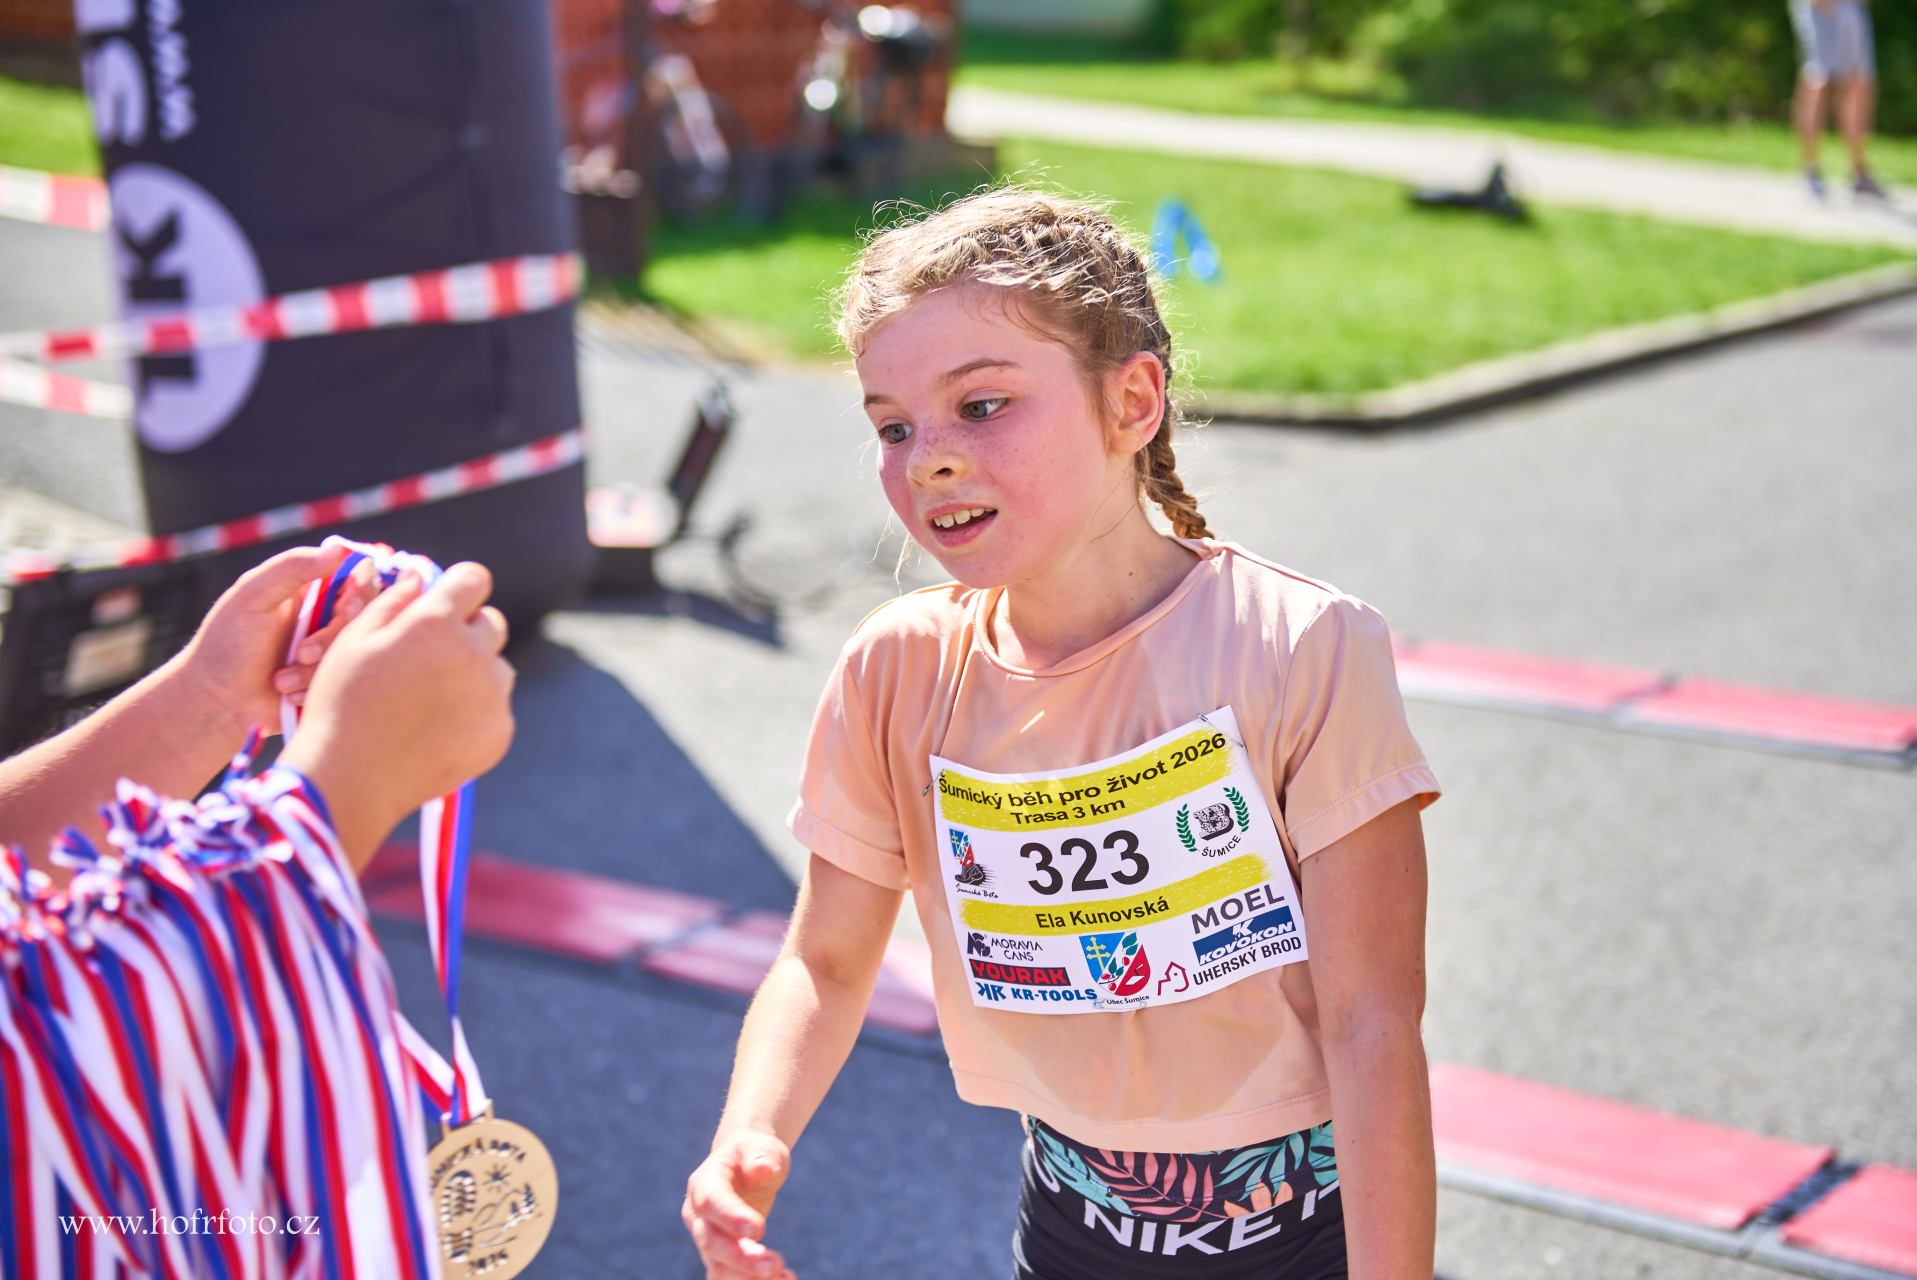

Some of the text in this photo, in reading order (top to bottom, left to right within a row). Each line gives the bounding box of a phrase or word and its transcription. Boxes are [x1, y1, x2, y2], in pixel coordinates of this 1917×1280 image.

[939, 733, 1226, 810] Šumický běh pro život 2026
[1010, 799, 1126, 824] Trasa 3 km
[1019, 829, 1150, 896] 323
[1201, 834, 1242, 858] ŠUMICE
[1035, 896, 1170, 929] Ela Kunovská
[1191, 884, 1285, 935] MOEL
[991, 937, 1044, 951] MORAVIA
[1003, 949, 1034, 962] CANS
[1199, 921, 1293, 966] KOVOKON
[970, 960, 1068, 985] YOURAK
[1192, 937, 1302, 986] UHERSKÝ BROD
[1010, 987, 1098, 1002] KR-TOOLS
[1083, 1198, 1282, 1256] NIKE
